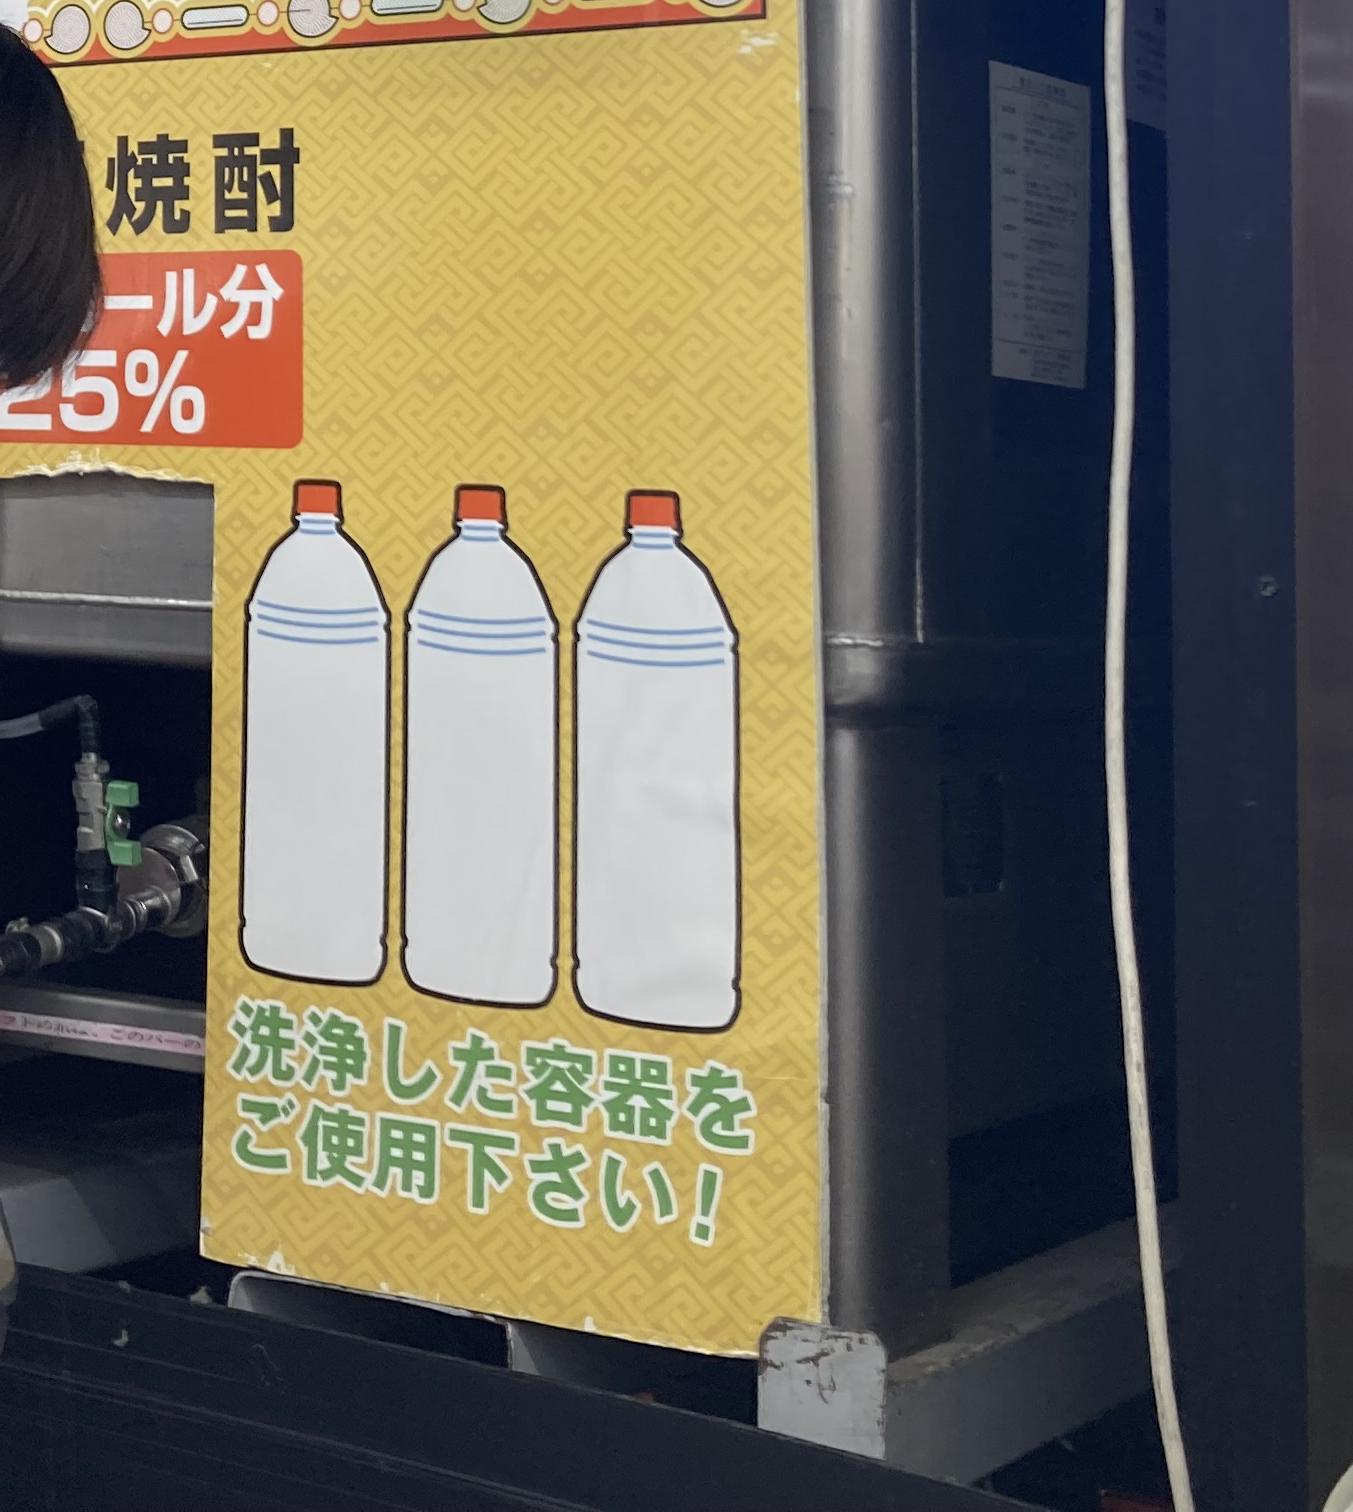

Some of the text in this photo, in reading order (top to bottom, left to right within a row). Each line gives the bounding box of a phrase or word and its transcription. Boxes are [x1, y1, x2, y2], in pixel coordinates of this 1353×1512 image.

[82, 263, 284, 339] ール分
[230, 997, 755, 1152] 洗浄した容器を
[232, 1094, 722, 1245] ご使用下さい!
